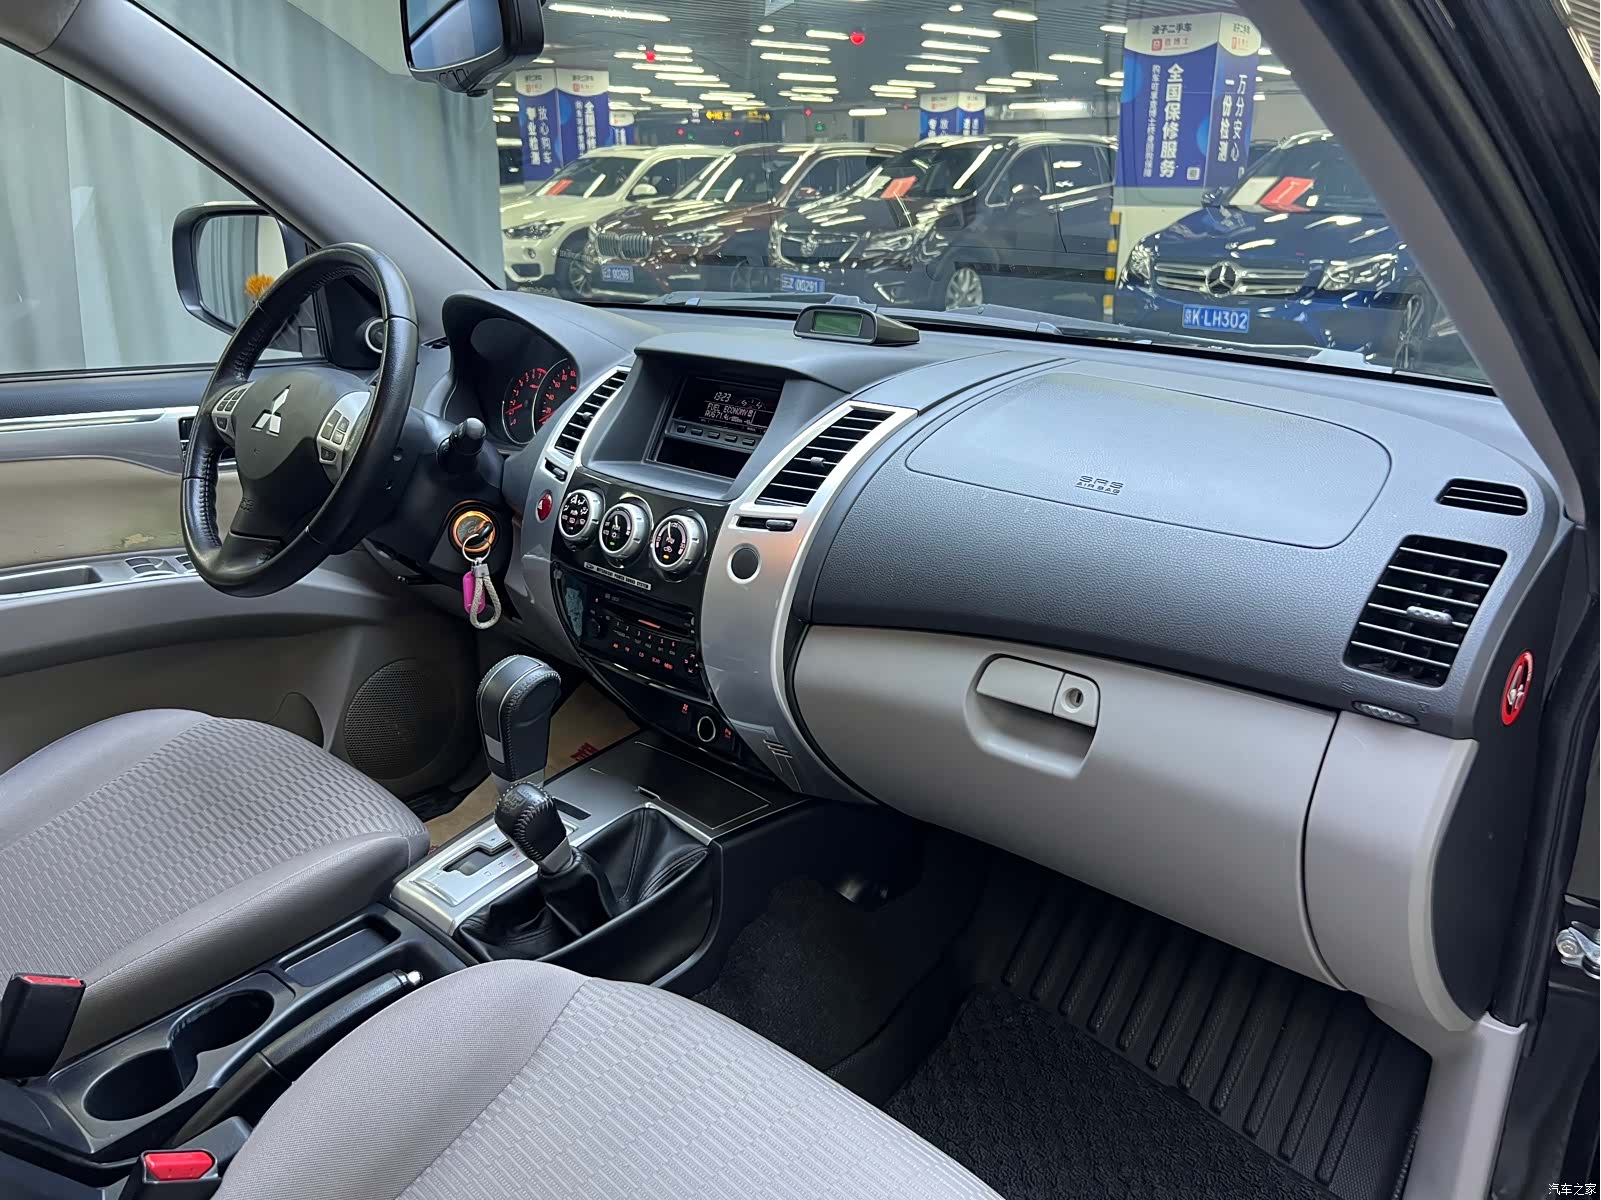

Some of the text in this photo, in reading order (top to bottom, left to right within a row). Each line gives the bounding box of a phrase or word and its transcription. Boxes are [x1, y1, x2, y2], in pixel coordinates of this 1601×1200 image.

[1159, 63, 1184, 178] 全国保修服务
[1230, 74, 1248, 162] 万分安心
[706, 402, 720, 412] FUEL
[1080, 475, 1124, 489] SRS
